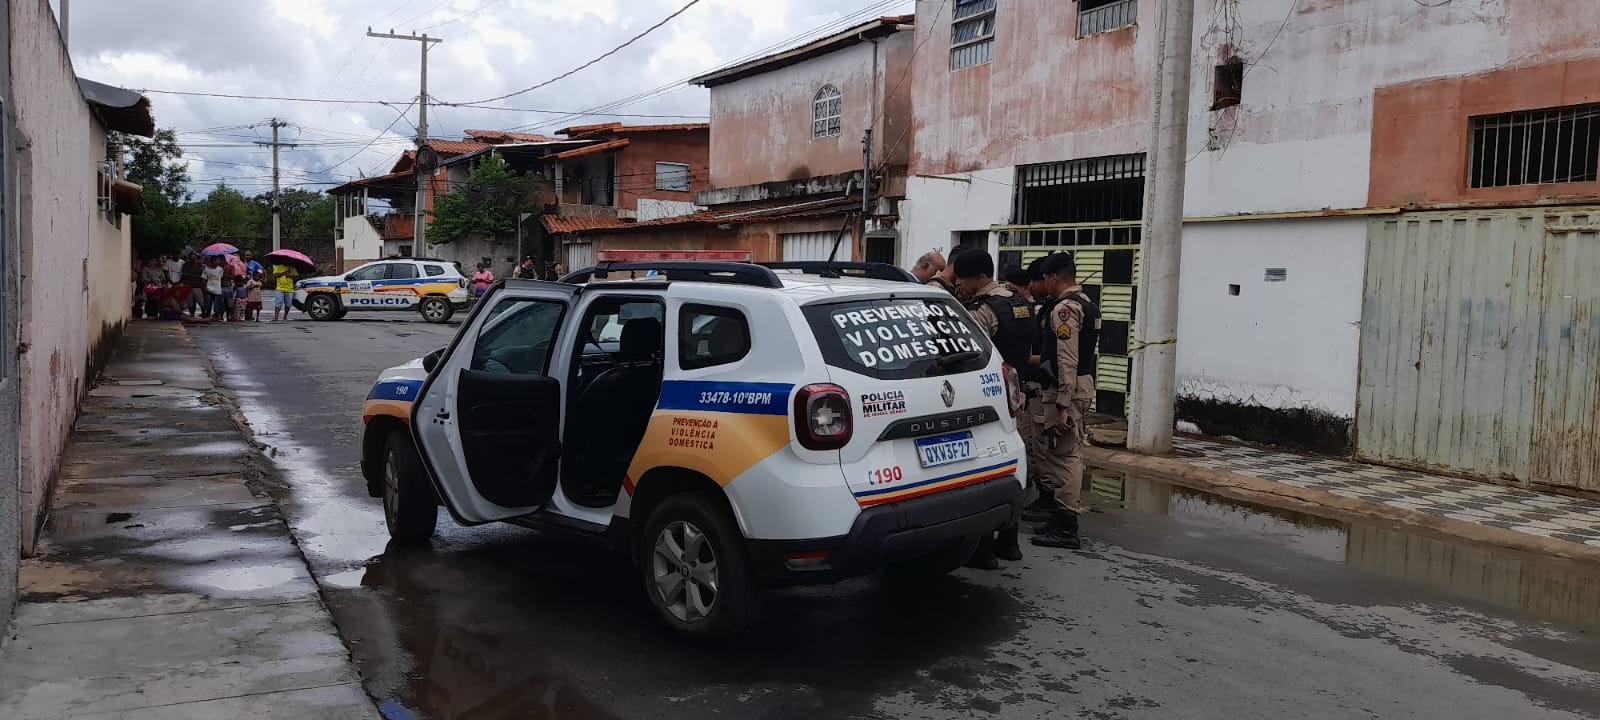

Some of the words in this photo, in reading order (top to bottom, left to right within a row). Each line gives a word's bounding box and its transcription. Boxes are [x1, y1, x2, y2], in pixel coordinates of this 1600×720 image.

[833, 303, 943, 328] PREVENÇÃO
[846, 319, 970, 346] VIOLÊNCIA
[859, 338, 982, 367] DOMÉSTICA
[396, 386, 408, 394] 190
[863, 401, 906, 413] MILITAR
[910, 413, 985, 432] DUSTER
[671, 427, 716, 439] VIOLÊNCIA
[925, 441, 970, 463] QXW3F27
[874, 466, 902, 484] 190
